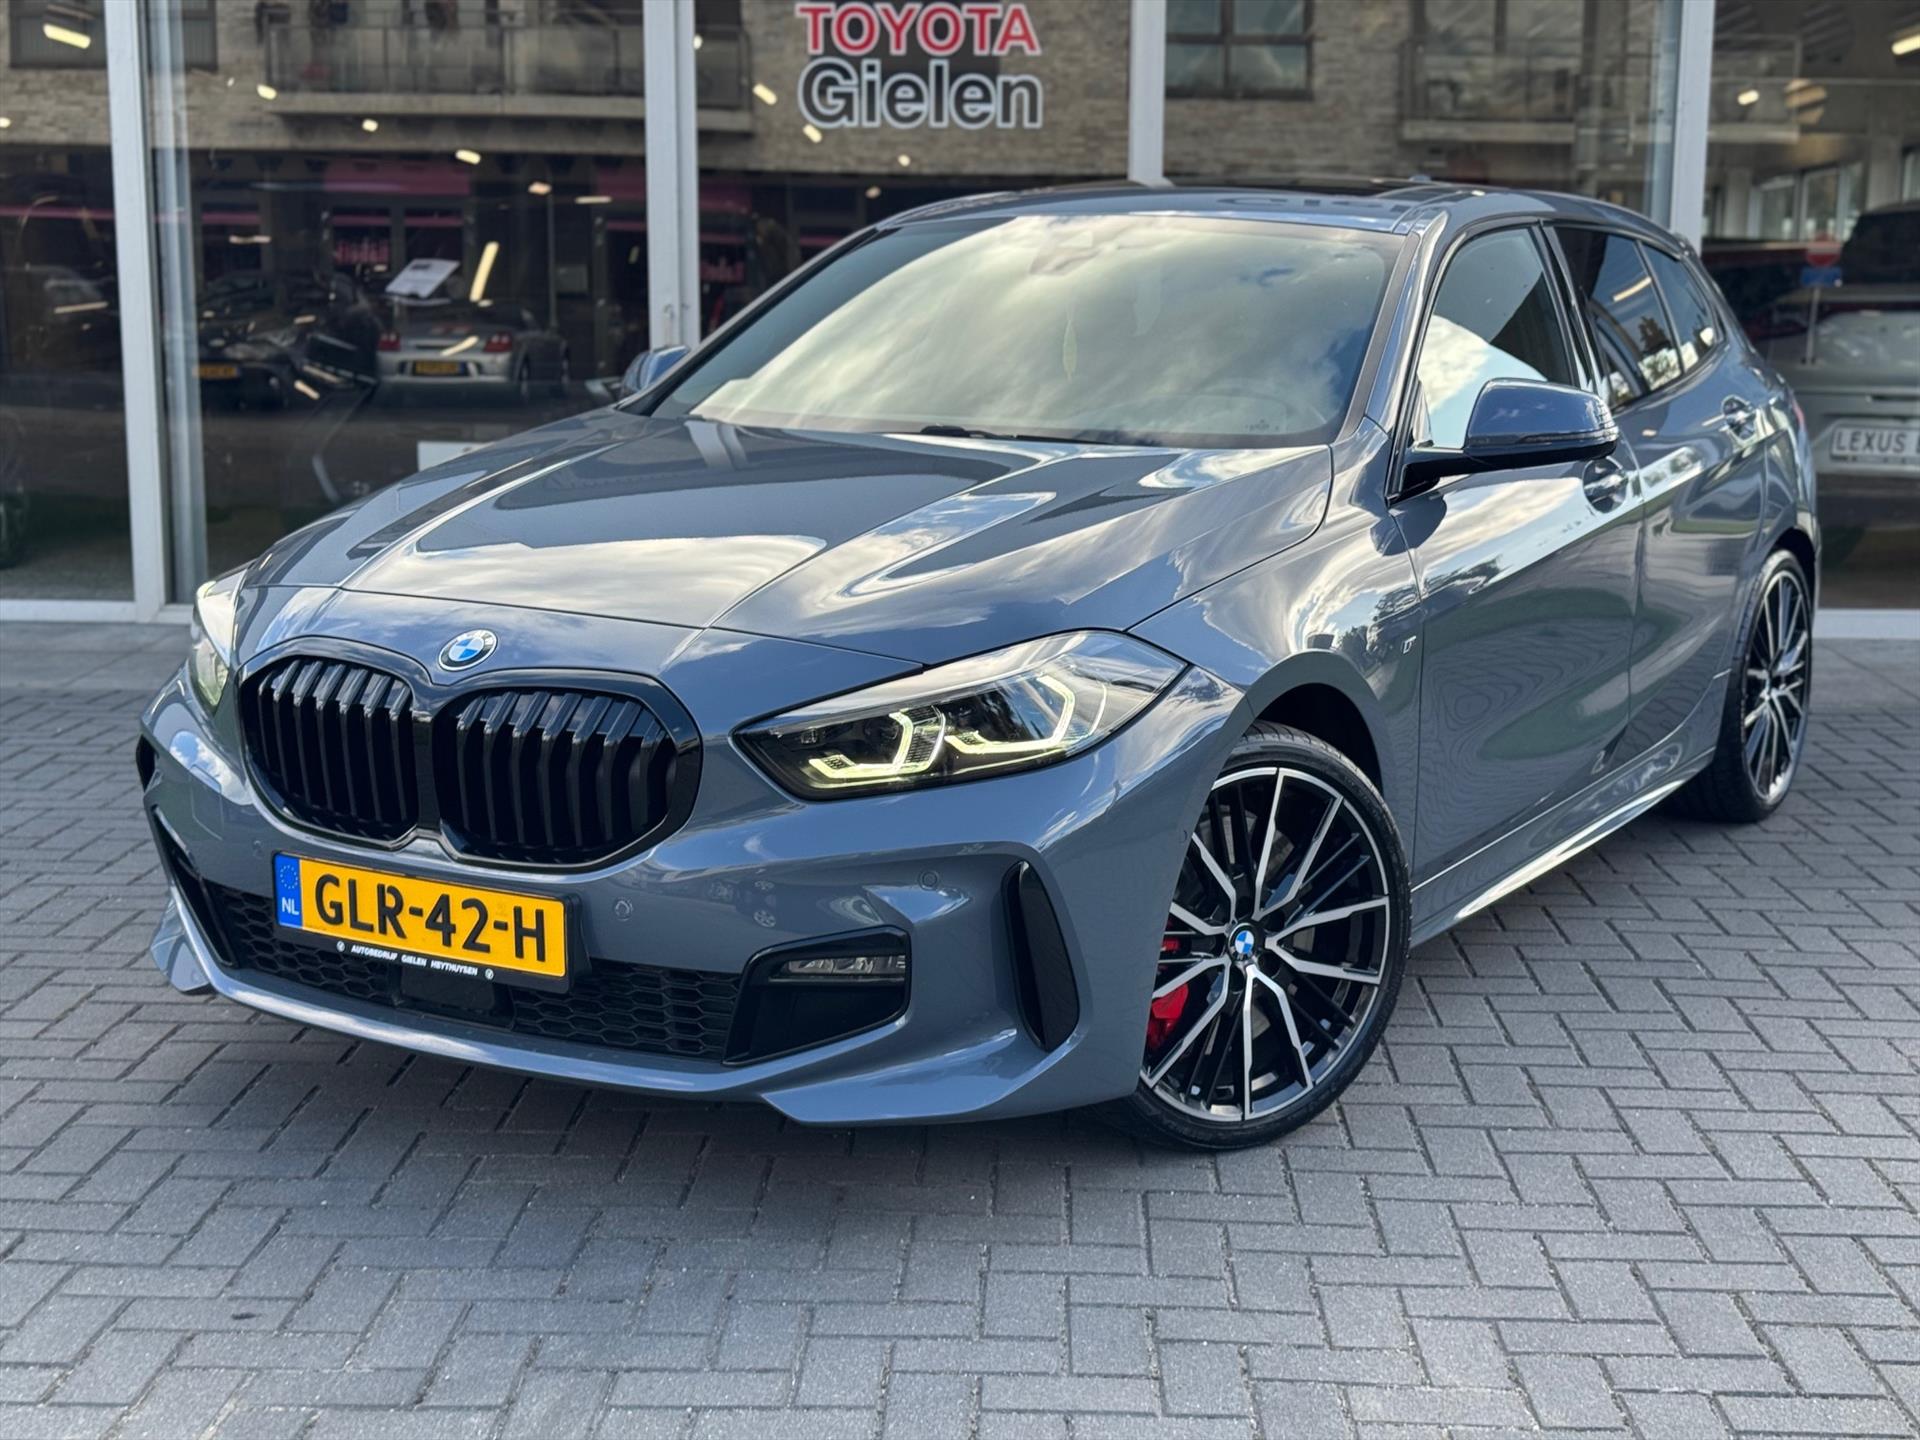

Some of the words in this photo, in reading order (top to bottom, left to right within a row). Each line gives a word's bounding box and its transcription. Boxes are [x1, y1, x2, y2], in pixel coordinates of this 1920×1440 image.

[796, 3, 1042, 55] TOYOTA
[798, 56, 1043, 129] Gielen
[1835, 430, 1907, 454] LEXUS
[281, 897, 299, 916] NL
[315, 873, 546, 962] GLR-42-H
[350, 944, 398, 961] AUTOBEDRIJF
[401, 954, 427, 968] GIELEN
[430, 960, 478, 977] HEYTHUYSEN
